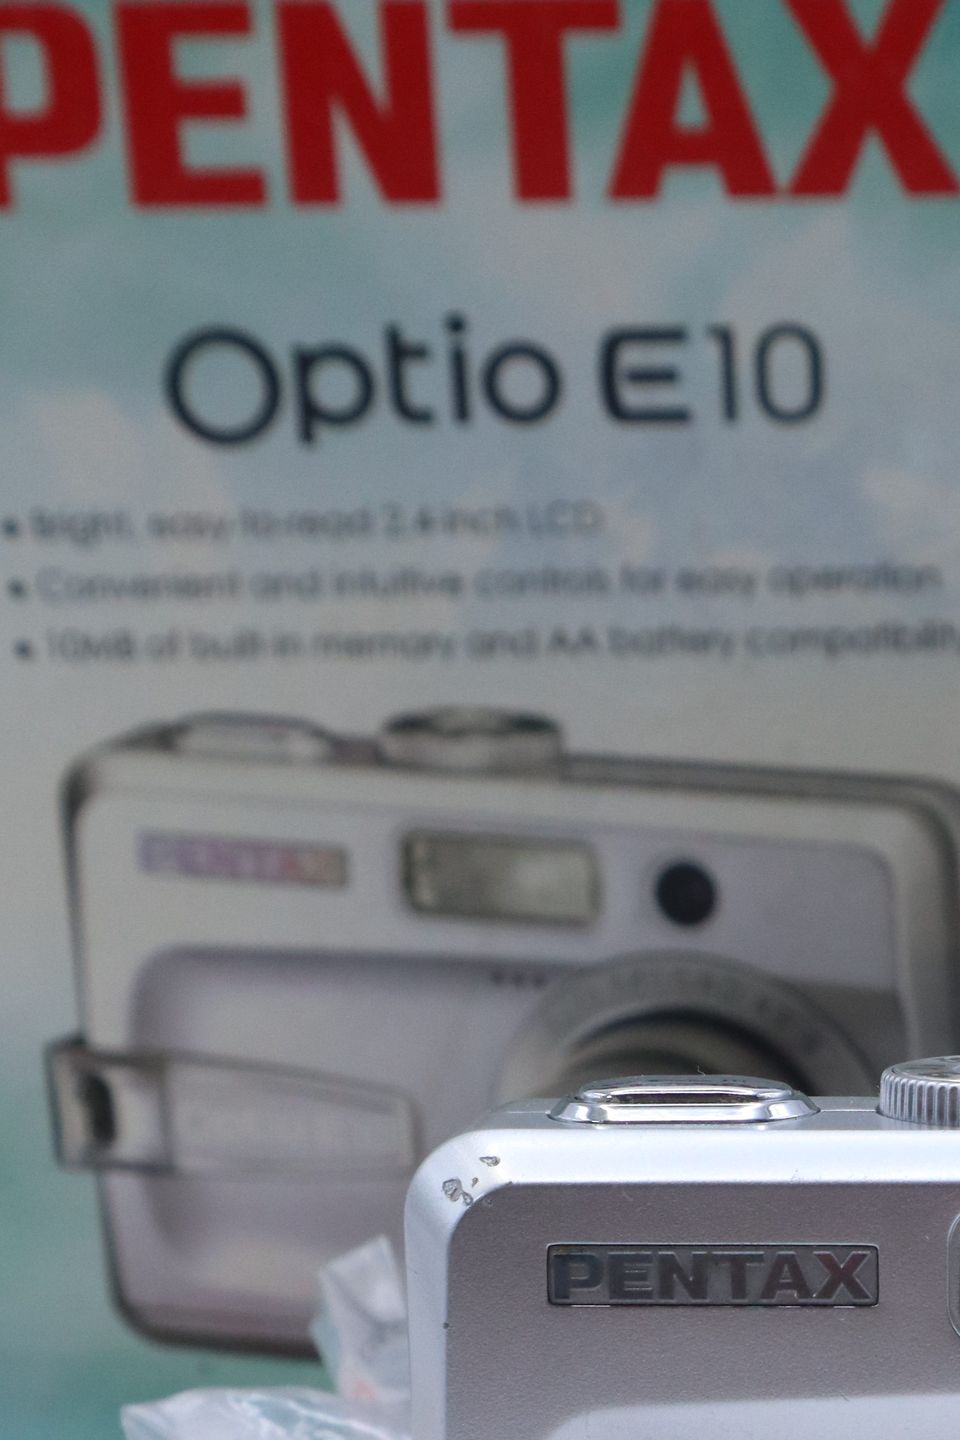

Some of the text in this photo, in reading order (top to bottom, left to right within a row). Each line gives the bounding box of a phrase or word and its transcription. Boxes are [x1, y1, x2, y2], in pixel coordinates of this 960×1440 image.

[164, 312, 825, 452] Optio E10
[250, 565, 320, 602] and
[554, 1251, 869, 1301] PENTAX
